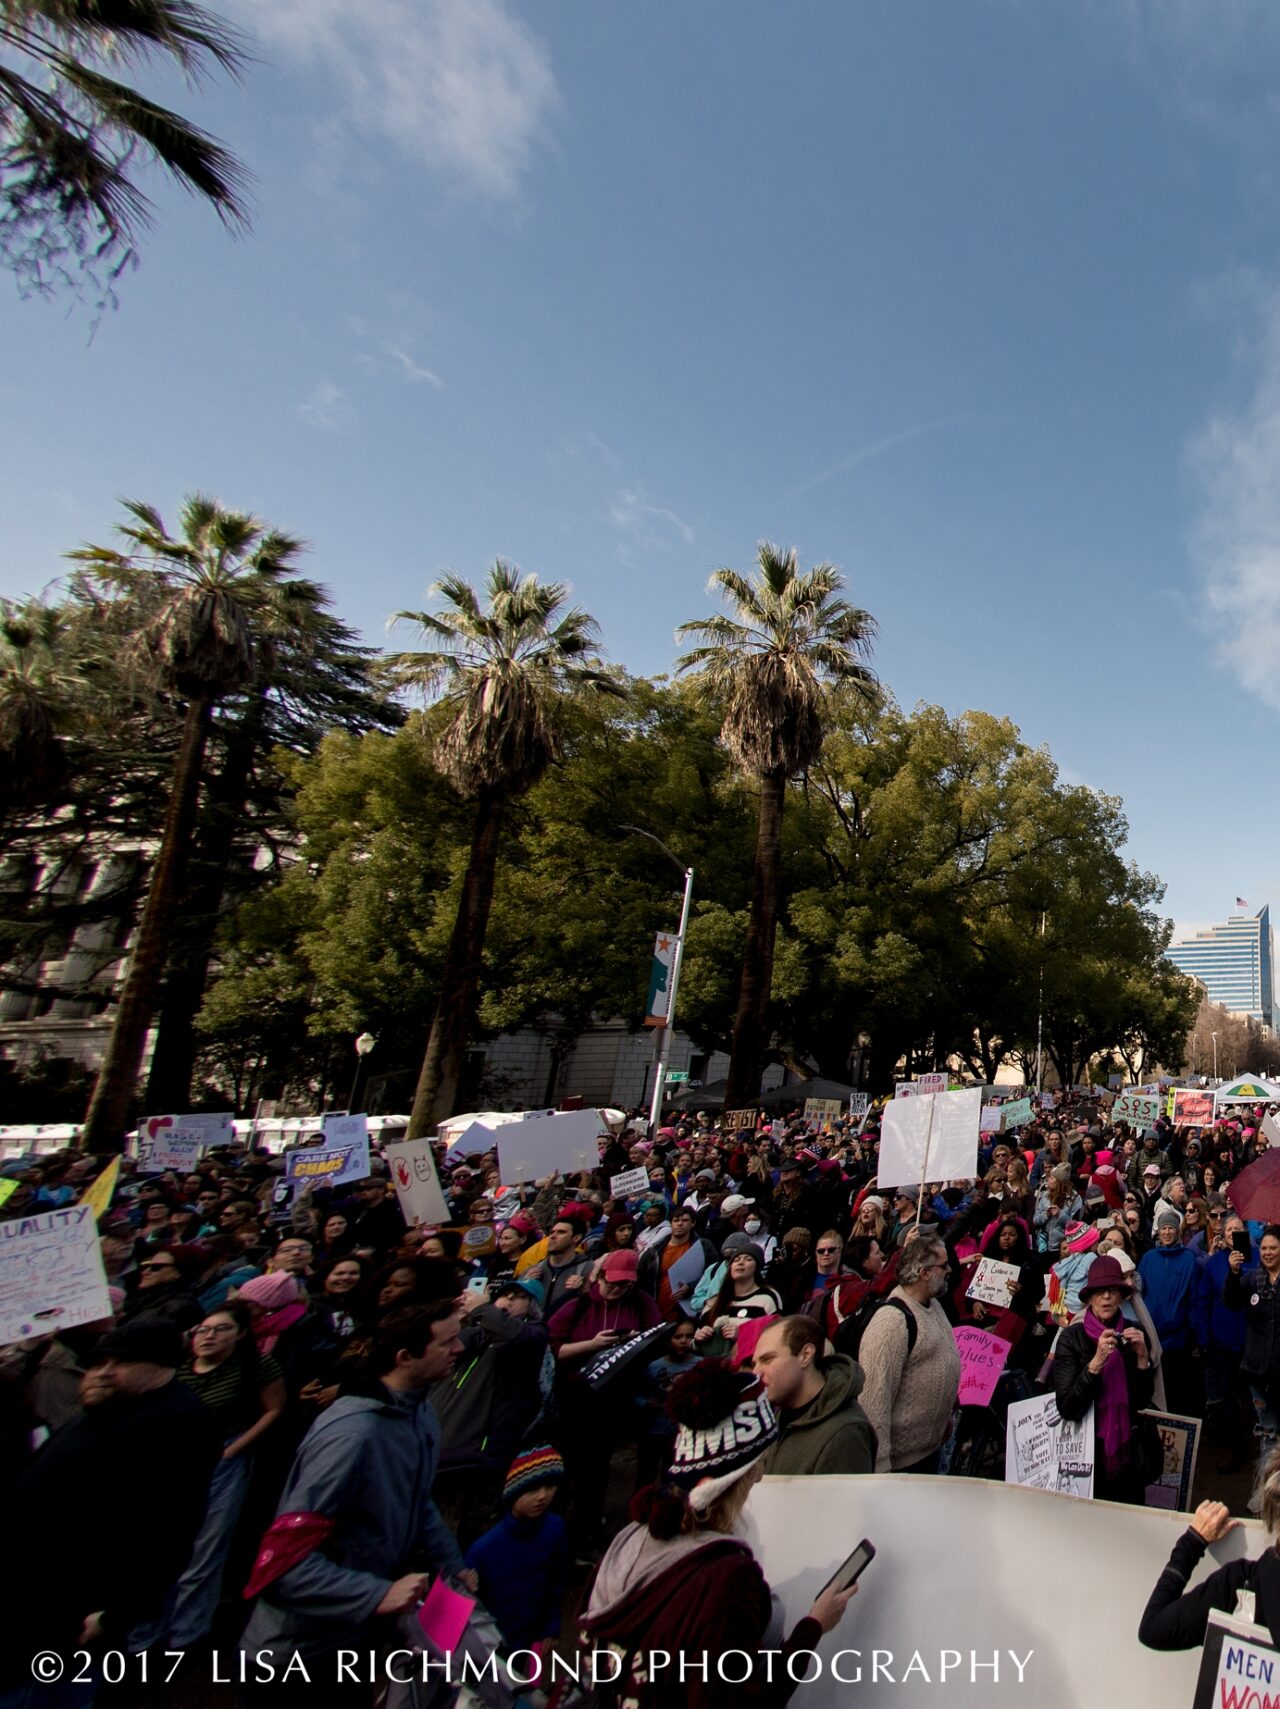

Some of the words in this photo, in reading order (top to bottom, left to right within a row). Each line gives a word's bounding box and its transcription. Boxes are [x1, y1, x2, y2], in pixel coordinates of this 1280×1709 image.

[920, 1076, 941, 1084] FIRED
[805, 1111, 838, 1120] NASTY
[296, 1153, 328, 1163] CARE
[329, 1149, 349, 1160] NOT
[293, 1158, 344, 1177] CHAOS
[0, 1207, 89, 1240] UALITY
[69, 1304, 109, 1323] HIGH
[956, 1329, 993, 1351] Family
[958, 1345, 994, 1367] alues
[1017, 1414, 1033, 1428] JOIN
[1031, 1438, 1049, 1451] RIGHTS
[1056, 1443, 1064, 1455] TO
[1065, 1442, 1083, 1455] SAVE
[1035, 1449, 1048, 1460] VOTE
[1024, 1455, 1051, 1474] DEMOCRAT
[1226, 1646, 1275, 1684] MEN
